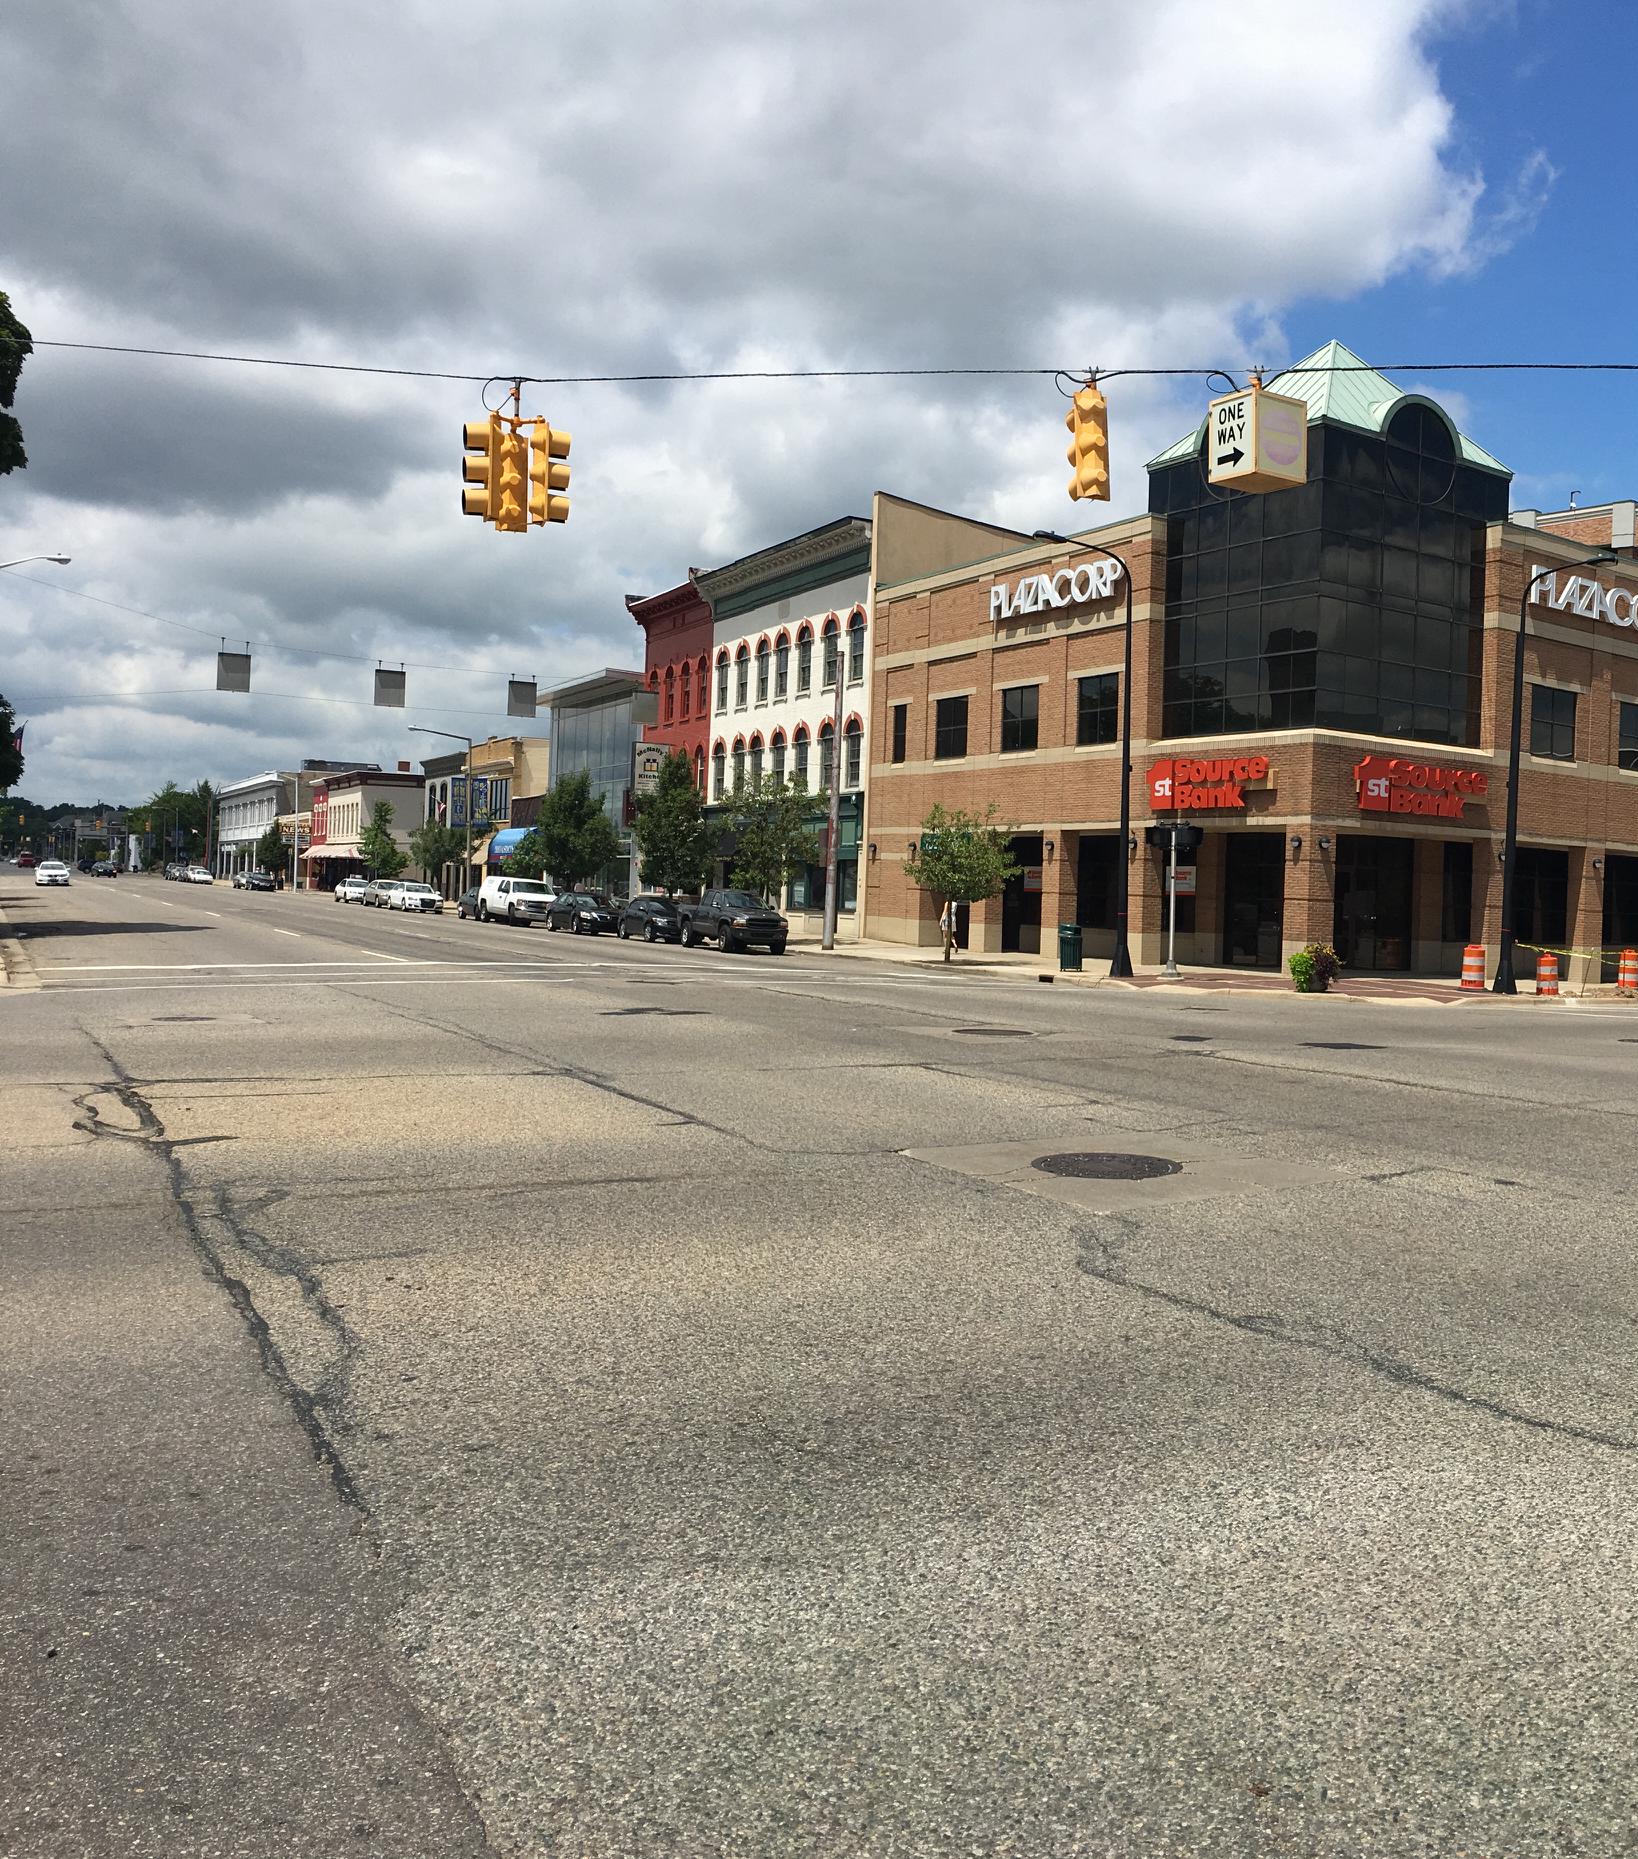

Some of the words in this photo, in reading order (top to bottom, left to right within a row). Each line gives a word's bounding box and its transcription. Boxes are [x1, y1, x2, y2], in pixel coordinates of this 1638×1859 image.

[1219, 402, 1245, 425] ONE
[1217, 422, 1246, 446] WAY
[989, 557, 1126, 621] PLAZACORP
[1174, 756, 1270, 784] Source
[1389, 759, 1489, 796] Source
[1174, 782, 1246, 809] Bank
[1390, 788, 1466, 819] Bank
